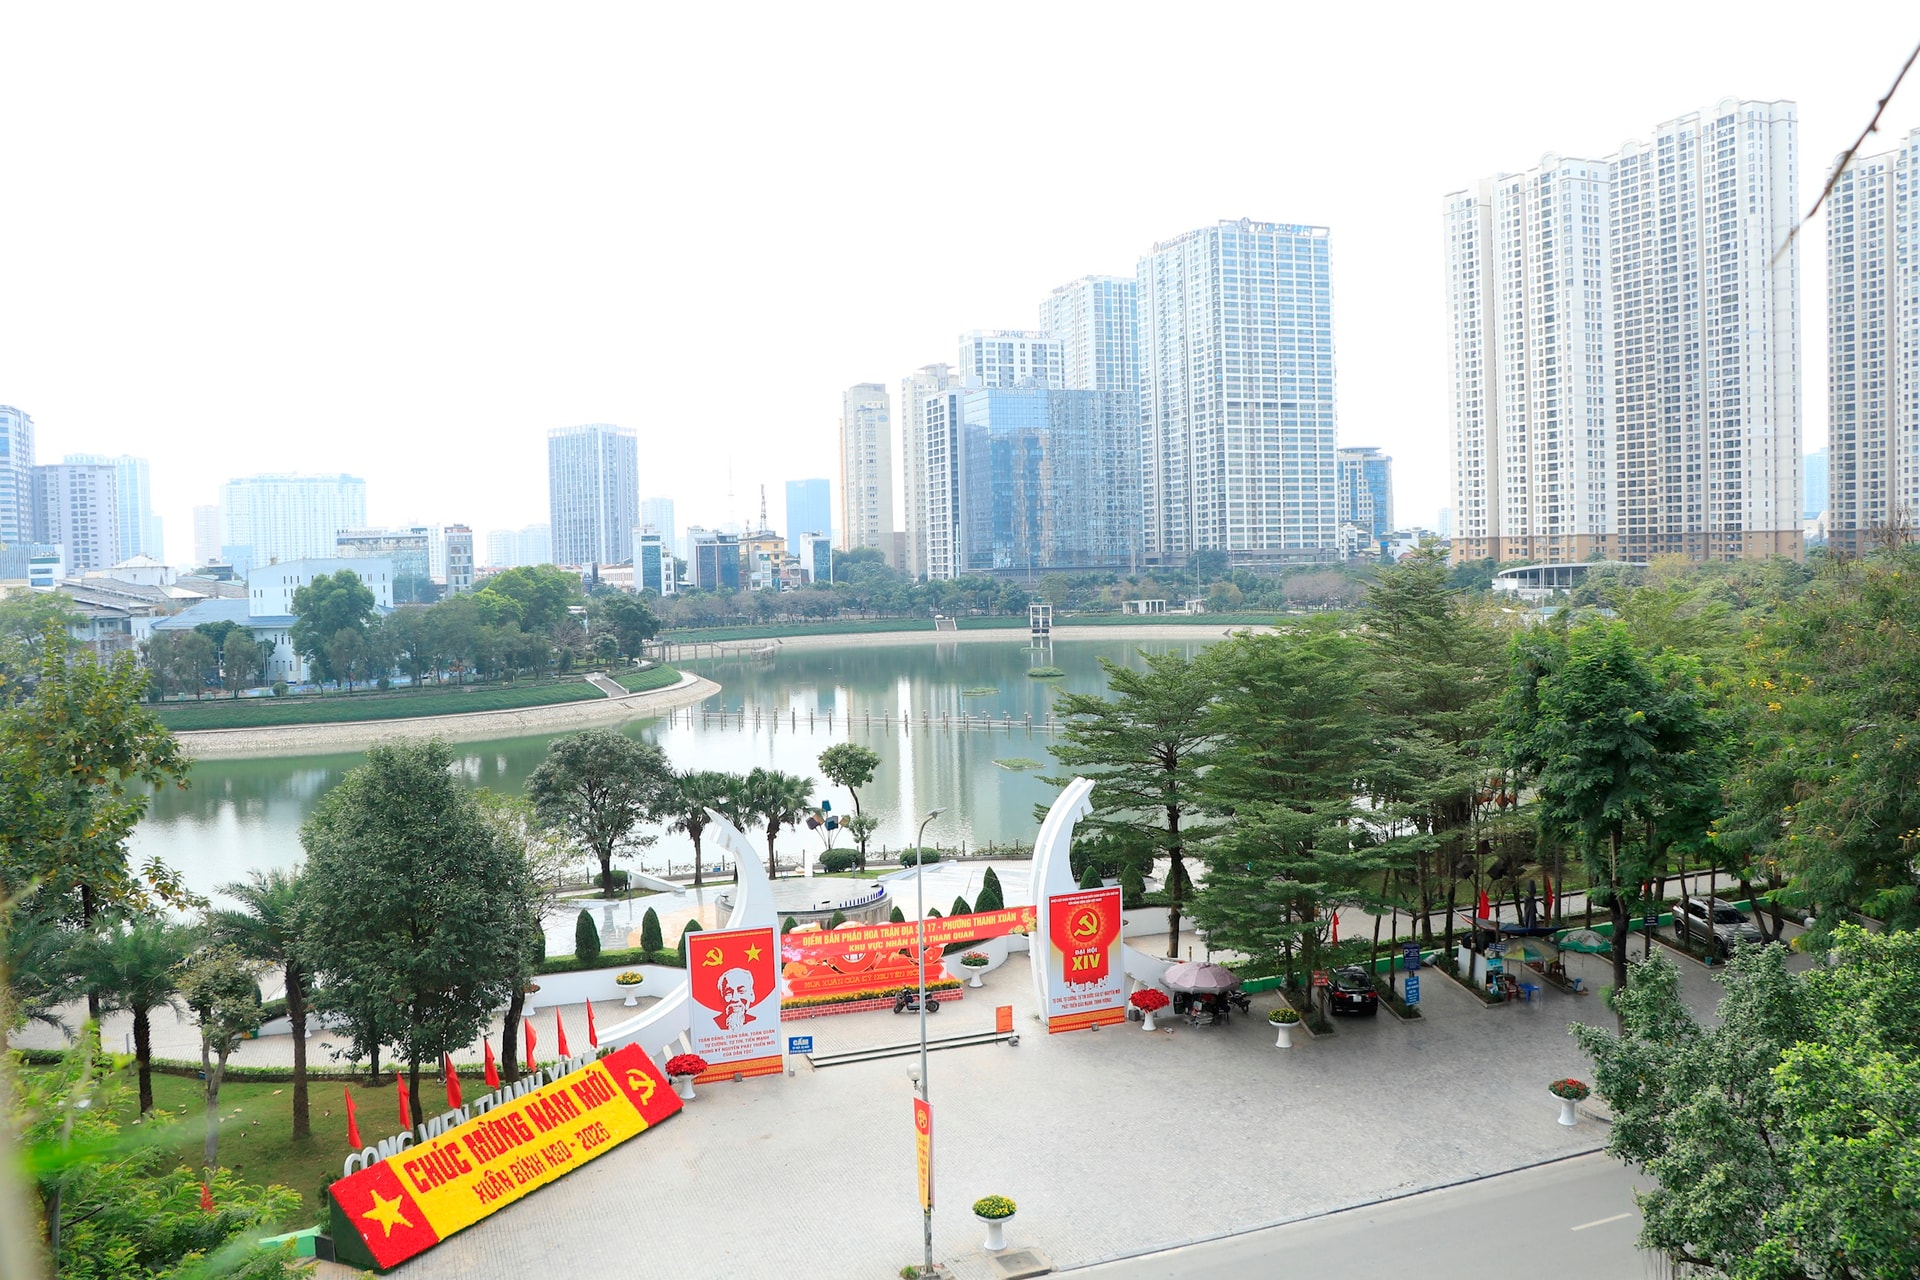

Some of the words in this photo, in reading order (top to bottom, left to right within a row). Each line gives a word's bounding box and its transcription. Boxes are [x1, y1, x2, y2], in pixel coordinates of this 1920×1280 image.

[863, 929, 879, 940] HOA
[881, 926, 899, 940] TRẬN
[901, 923, 914, 937] ĐỊA
[927, 922, 937, 932] 17
[973, 914, 996, 927] THANH
[997, 911, 1017, 923] XUÂN
[849, 943, 867, 952] KHU
[868, 941, 884, 951] VỰC
[885, 938, 909, 949] NHÂN
[929, 933, 952, 943] THAM
[953, 930, 975, 940] QUAN
[1071, 953, 1101, 971] XIV
[403, 1142, 473, 1194] CHÚC
[461, 1111, 536, 1166] MỪNG
[524, 1089, 582, 1134] NĂM
[570, 1068, 618, 1112] MỚI
[471, 1168, 517, 1205] XUÂN
[508, 1152, 547, 1186] BÍNH
[573, 1120, 612, 1152] 2026
